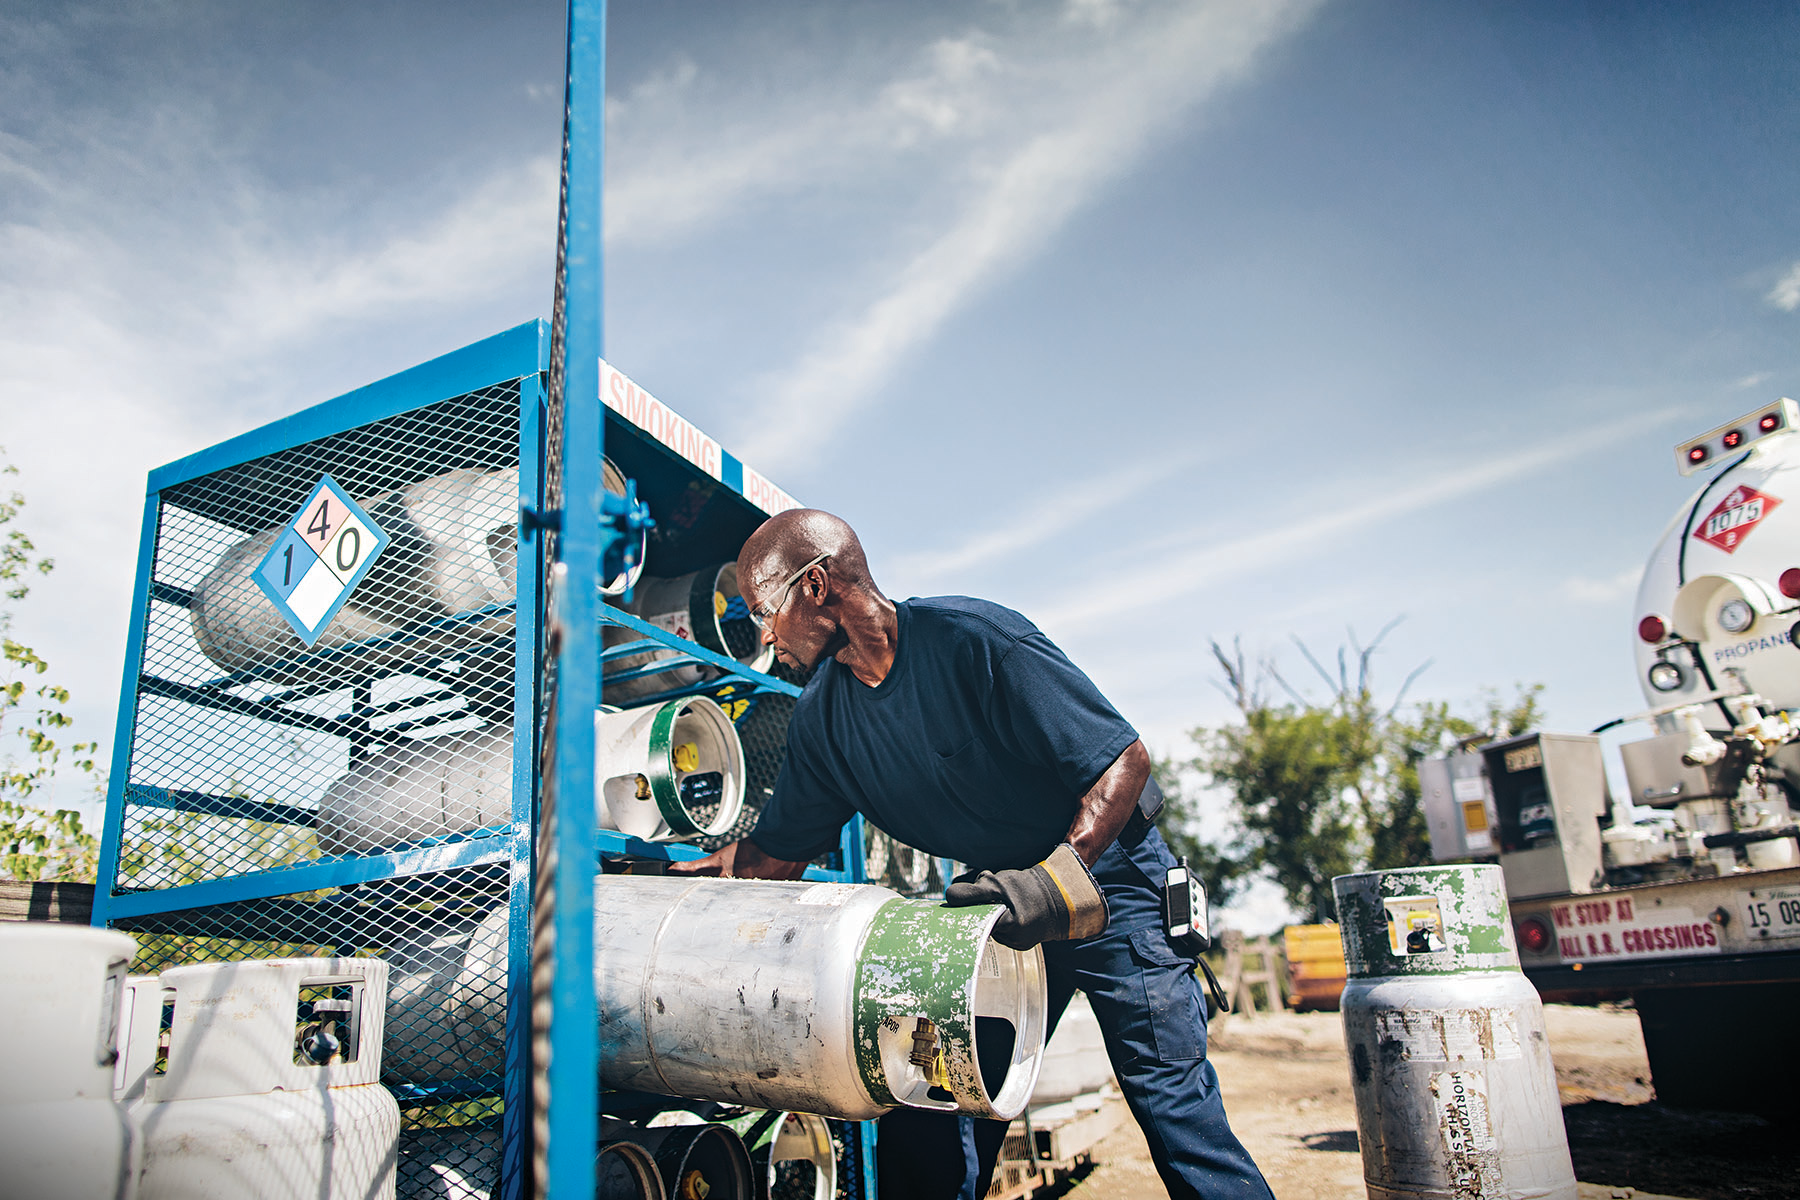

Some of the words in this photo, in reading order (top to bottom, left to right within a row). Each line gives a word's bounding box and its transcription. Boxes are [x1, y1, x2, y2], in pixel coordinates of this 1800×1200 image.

[608, 372, 715, 478] SMOKING
[307, 499, 331, 541] 4
[1710, 502, 1759, 533] 1075
[336, 526, 361, 572] 0
[1726, 532, 1737, 545] 2
[283, 543, 294, 587] 1
[1551, 904, 1573, 929] WE
[1575, 901, 1611, 926] STOP
[1616, 898, 1634, 922] AT
[1748, 903, 1771, 928] 15
[1559, 935, 1585, 959] ALL
[1622, 922, 1718, 953] CROSSINGS
[881, 1016, 900, 1034] APOR
[1446, 1106, 1461, 1139] THIS
[1451, 1074, 1477, 1160] HORIZONTAL
